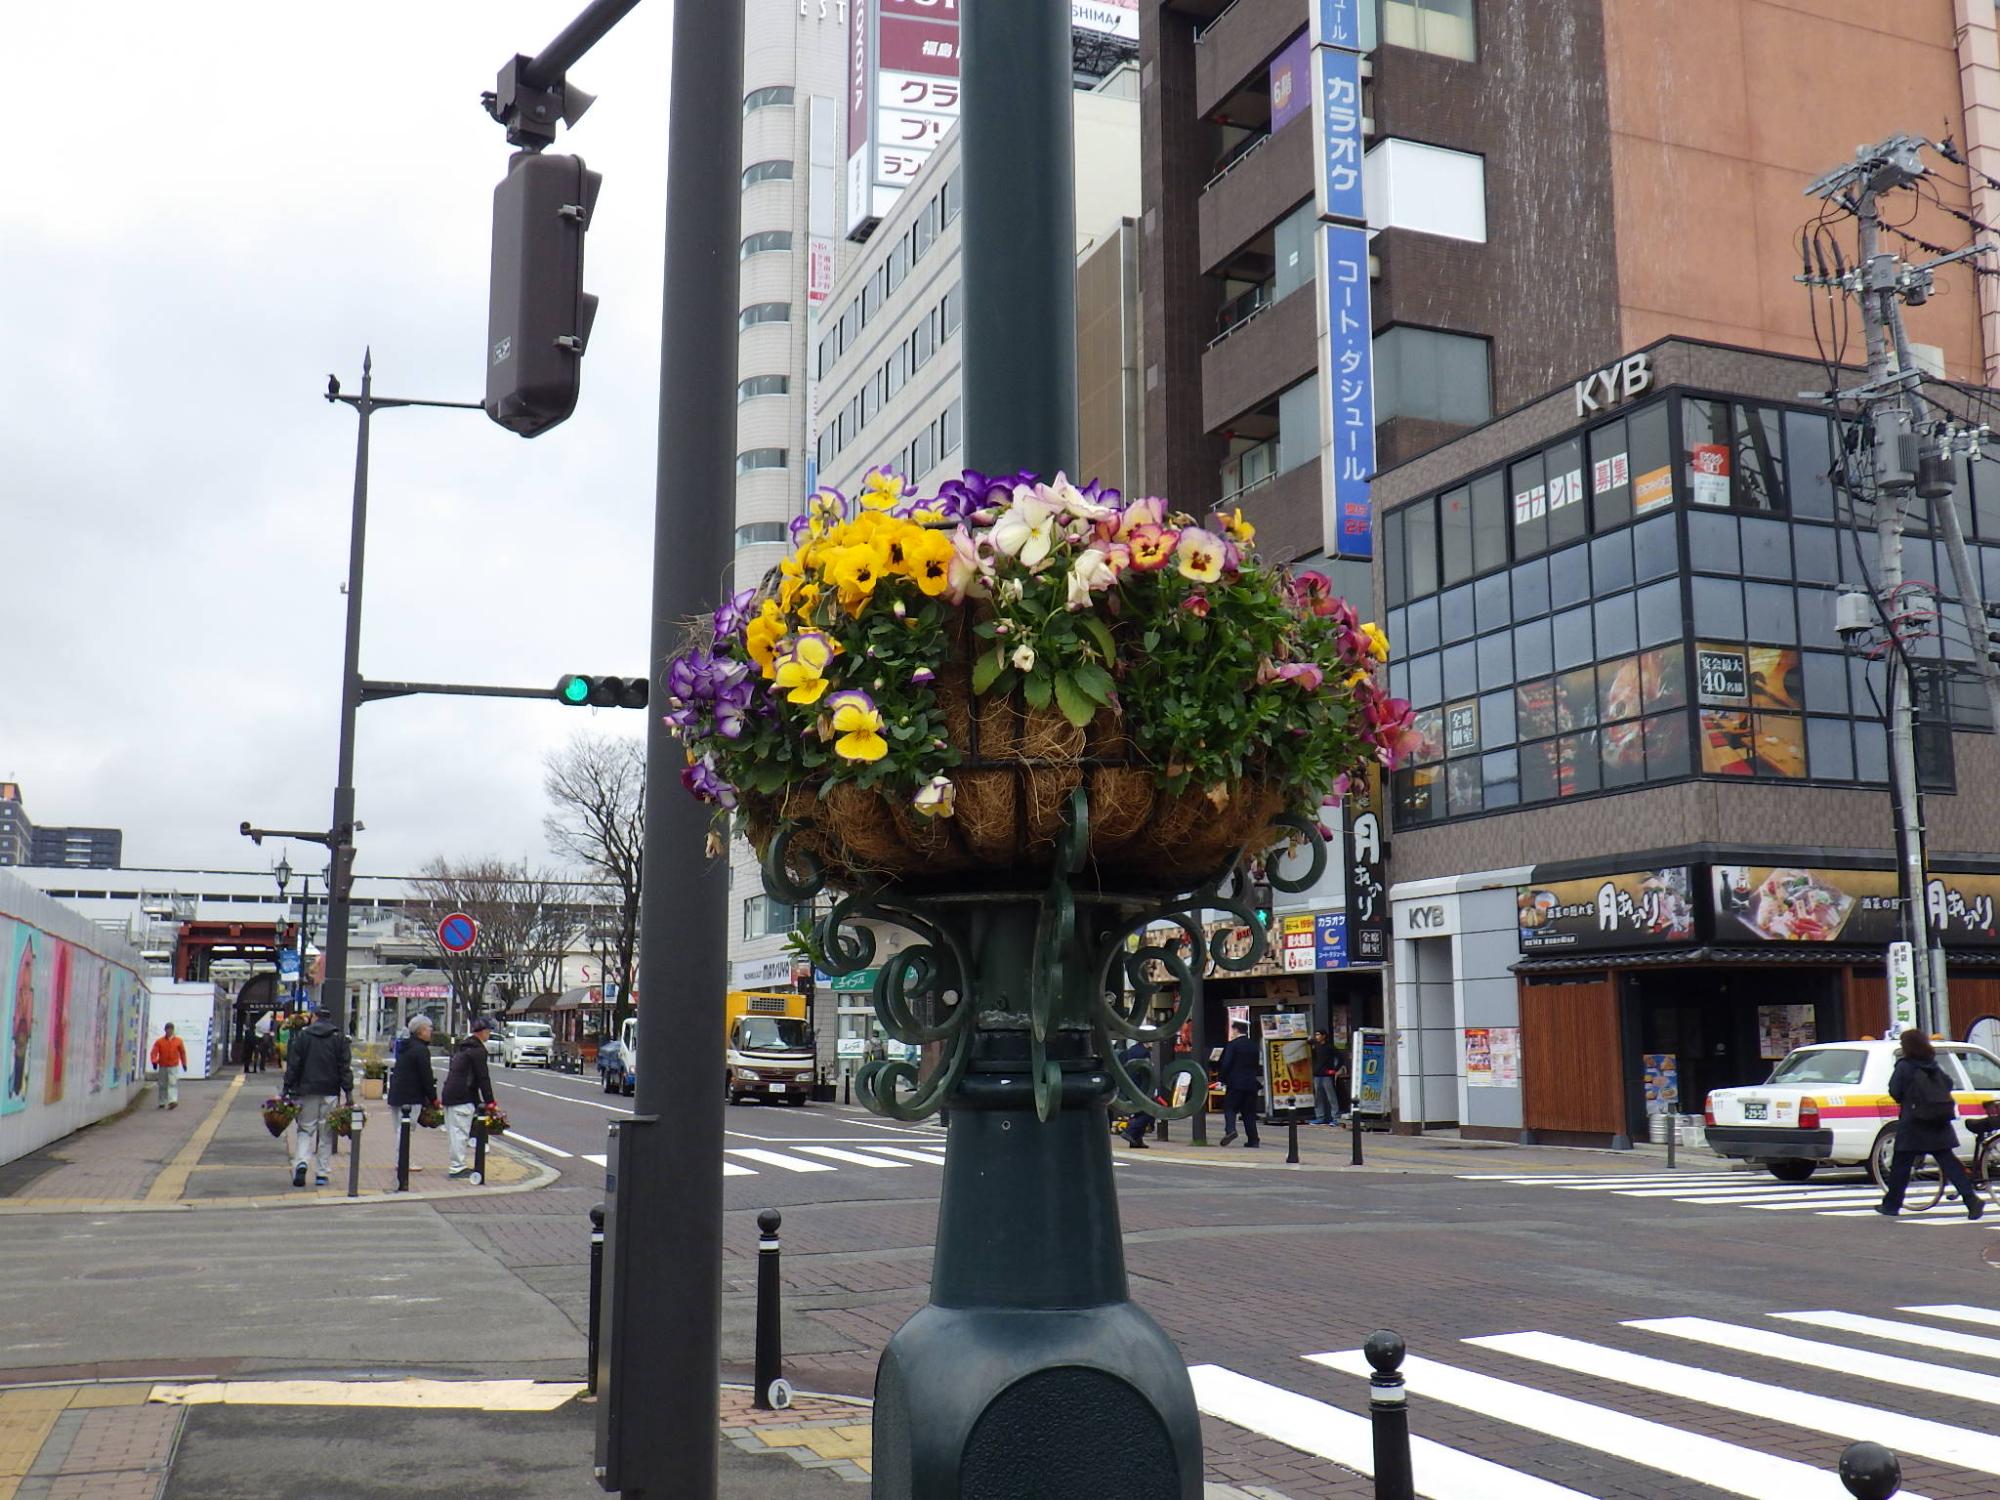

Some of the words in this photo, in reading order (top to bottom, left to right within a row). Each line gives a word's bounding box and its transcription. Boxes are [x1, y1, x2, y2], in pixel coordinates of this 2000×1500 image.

[1072, 5, 1114, 25] SHIMA
[855, 0, 864, 110] OYOTA
[922, 40, 960, 59] 福島
[1328, 77, 1358, 190] カラオケ
[1338, 260, 1366, 481] コート・ダジュール
[1575, 353, 1649, 417] KYB
[1701, 657, 1742, 671] 宴会最大
[1354, 812, 1382, 921] 月あかり
[1318, 916, 1345, 927] カラオケ
[1409, 905, 1444, 929] KYB
[1598, 883, 1660, 931] 月あかり
[1928, 880, 1993, 930] 月あかり
[1896, 976, 1910, 1022] BAR
